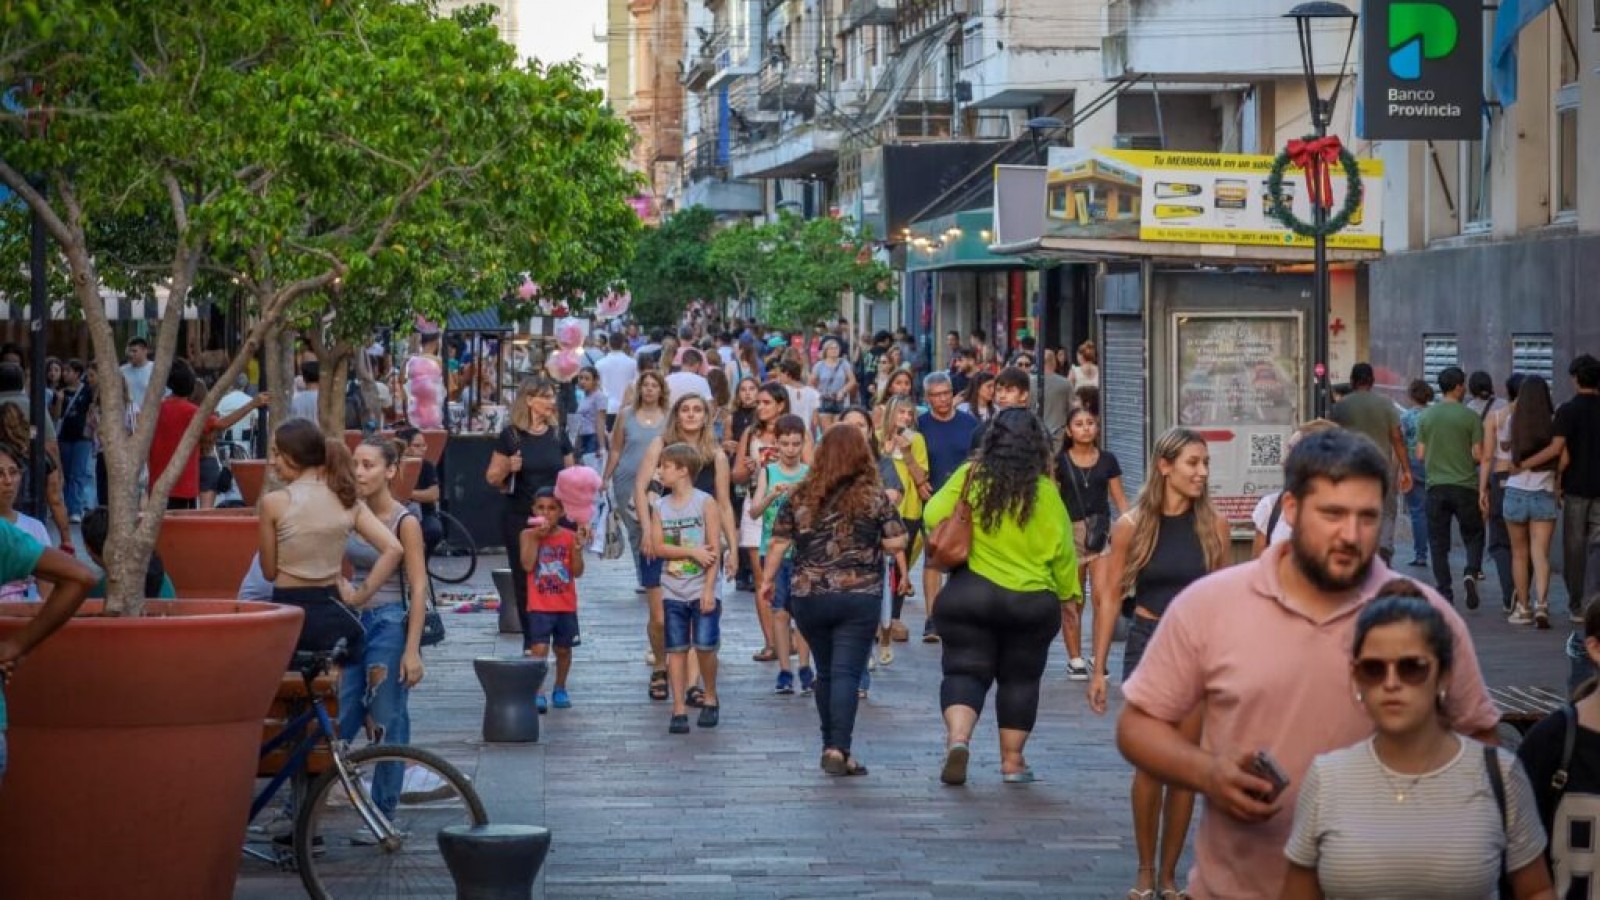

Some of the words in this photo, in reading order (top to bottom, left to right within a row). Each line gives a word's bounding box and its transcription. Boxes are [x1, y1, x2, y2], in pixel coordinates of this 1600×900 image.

[1388, 88, 1435, 101] Banco
[1388, 103, 1461, 117] Provincia
[1154, 155, 1165, 165] Tu
[1167, 155, 1221, 168] MEMBRANA
